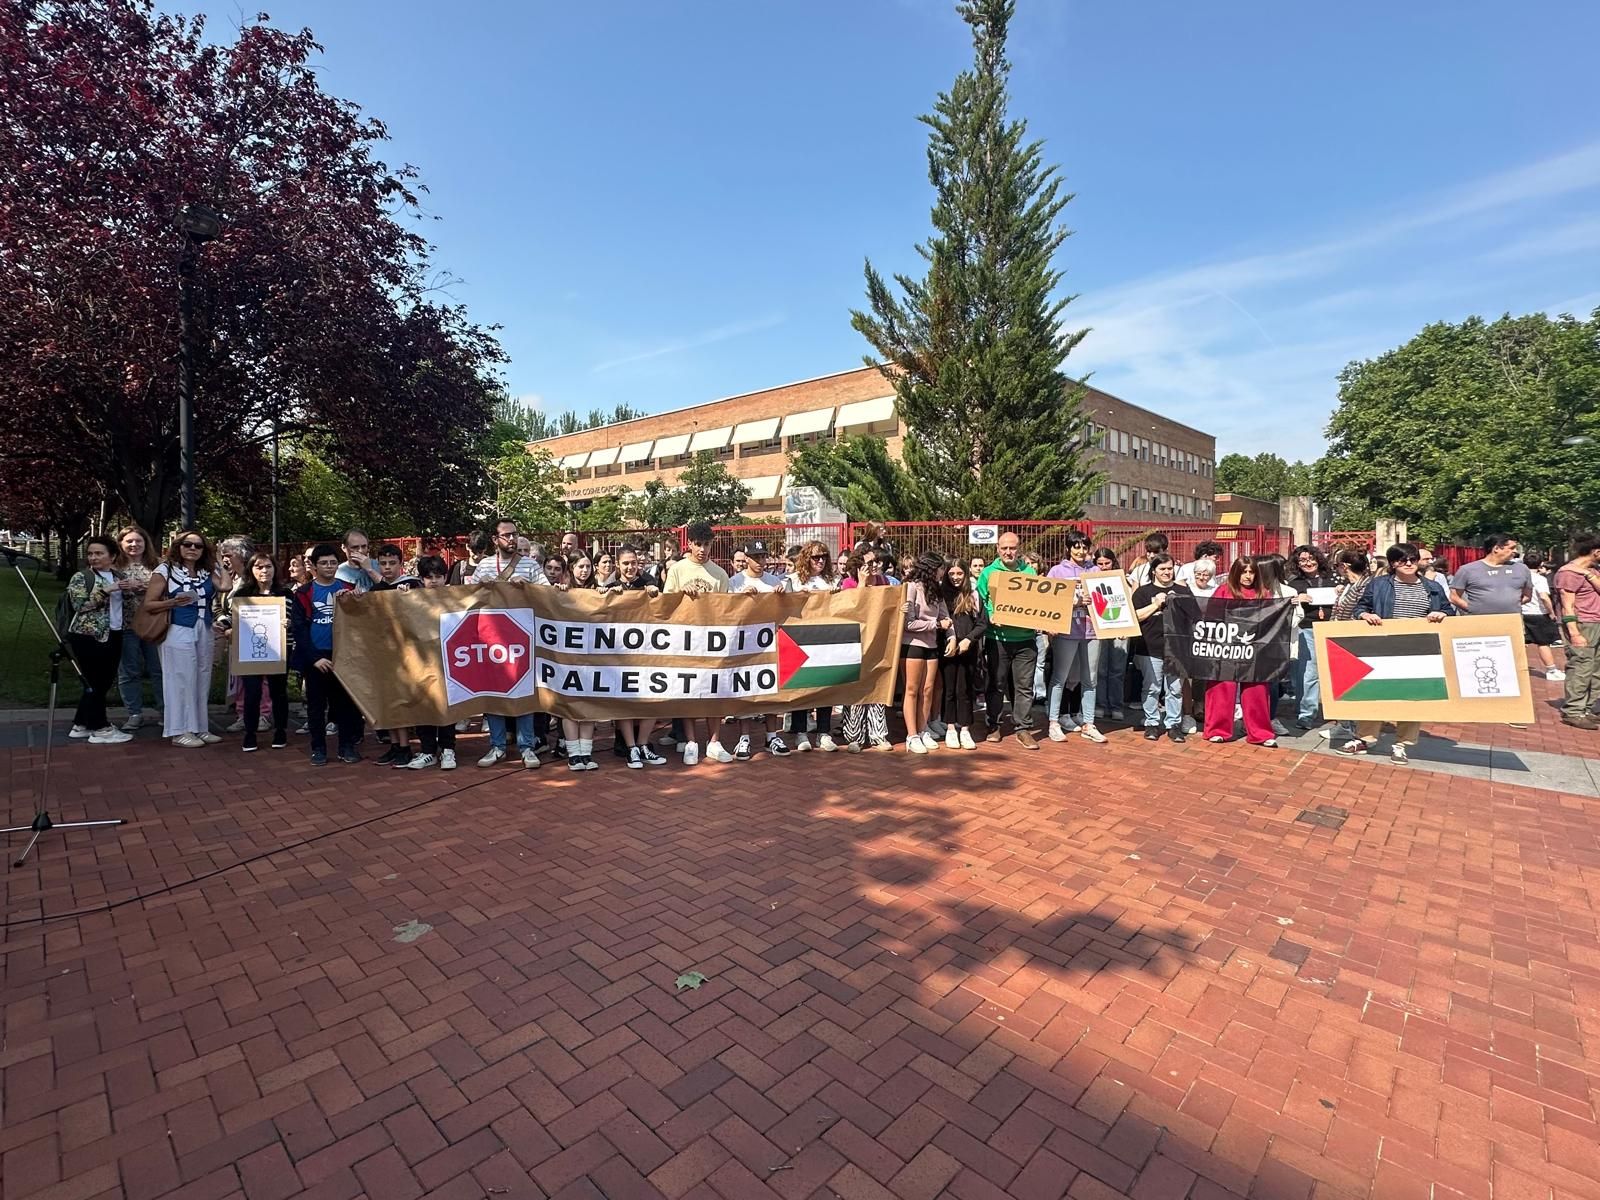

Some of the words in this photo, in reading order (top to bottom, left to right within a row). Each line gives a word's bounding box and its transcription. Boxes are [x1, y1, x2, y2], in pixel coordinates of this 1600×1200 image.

[1007, 576, 1068, 596] STOP
[995, 603, 1062, 620] GENOCIDIO
[540, 623, 774, 652] GENOCIDIO
[1193, 620, 1239, 643] STOP
[454, 643, 526, 667] STOP
[1192, 641, 1254, 660] GENOCIDIO
[541, 662, 776, 694] PALESTINO
